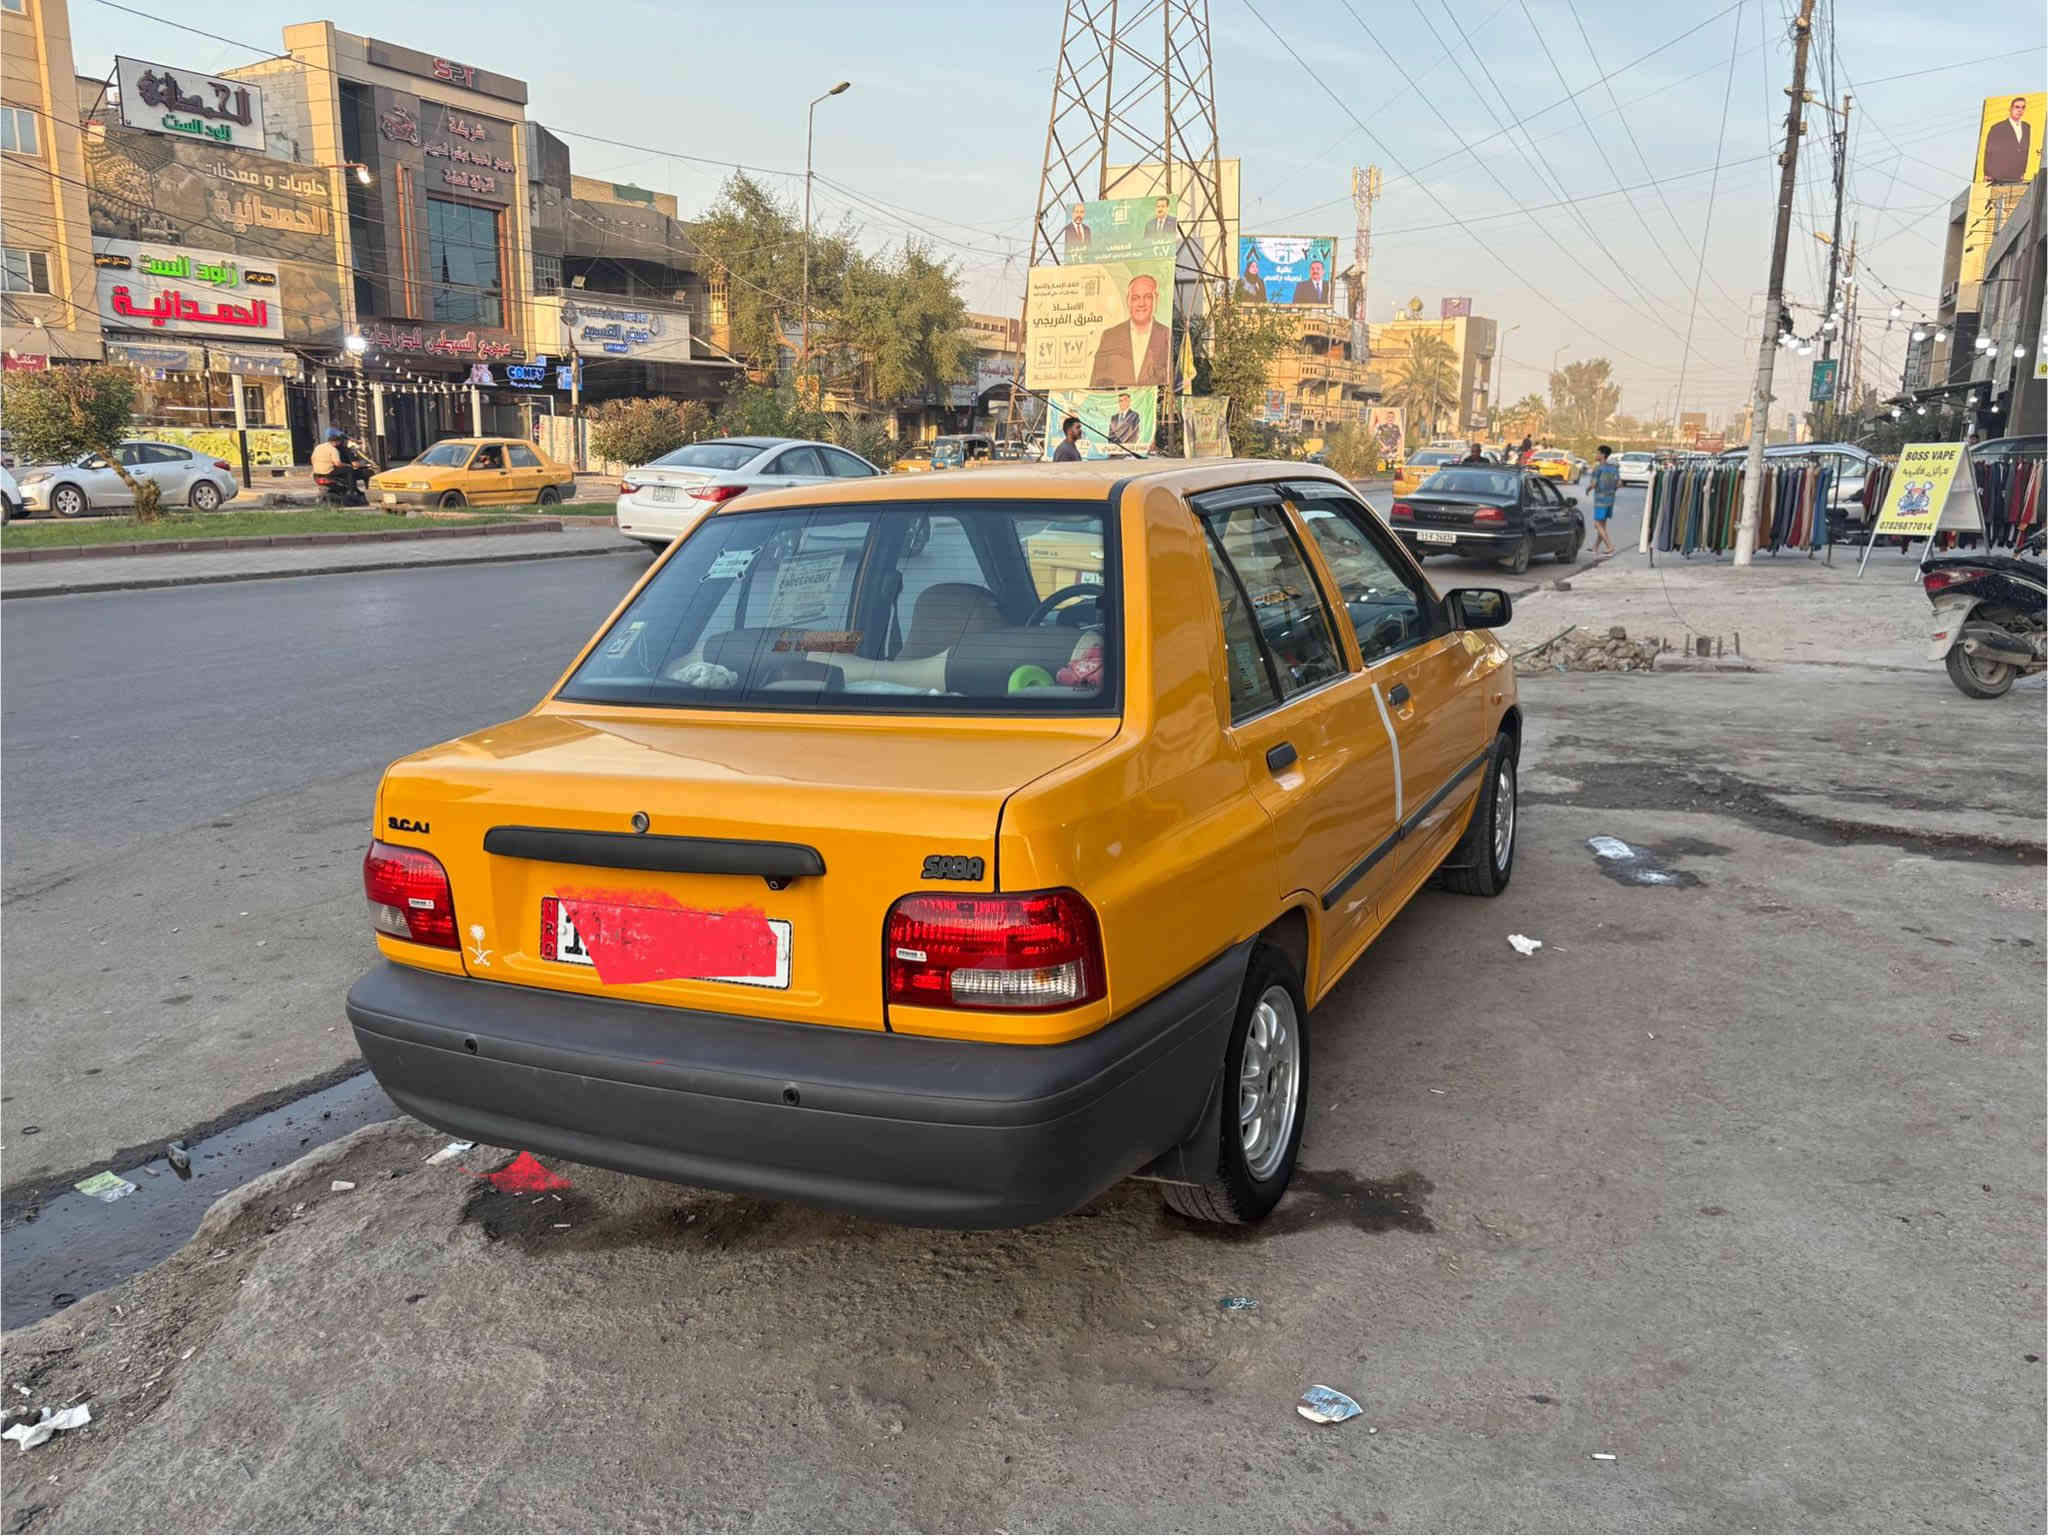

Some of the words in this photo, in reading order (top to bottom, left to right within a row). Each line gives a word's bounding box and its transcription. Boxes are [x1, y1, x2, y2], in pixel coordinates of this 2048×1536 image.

[433, 58, 475, 88] SPT
[206, 162, 259, 185] معجنات
[263, 175, 274, 190] و
[279, 174, 328, 197] حلويات
[137, 255, 190, 279] الست
[196, 260, 239, 288] زنود
[112, 285, 268, 328] الحمدانية
[1033, 314, 1072, 328] الفريجي
[1074, 312, 1104, 327] مشرق
[1064, 341, 1084, 354] ٢٠٧
[1905, 450, 1930, 461] BOSS
[1932, 450, 1956, 460] VAPE
[921, 855, 985, 881] SABA
